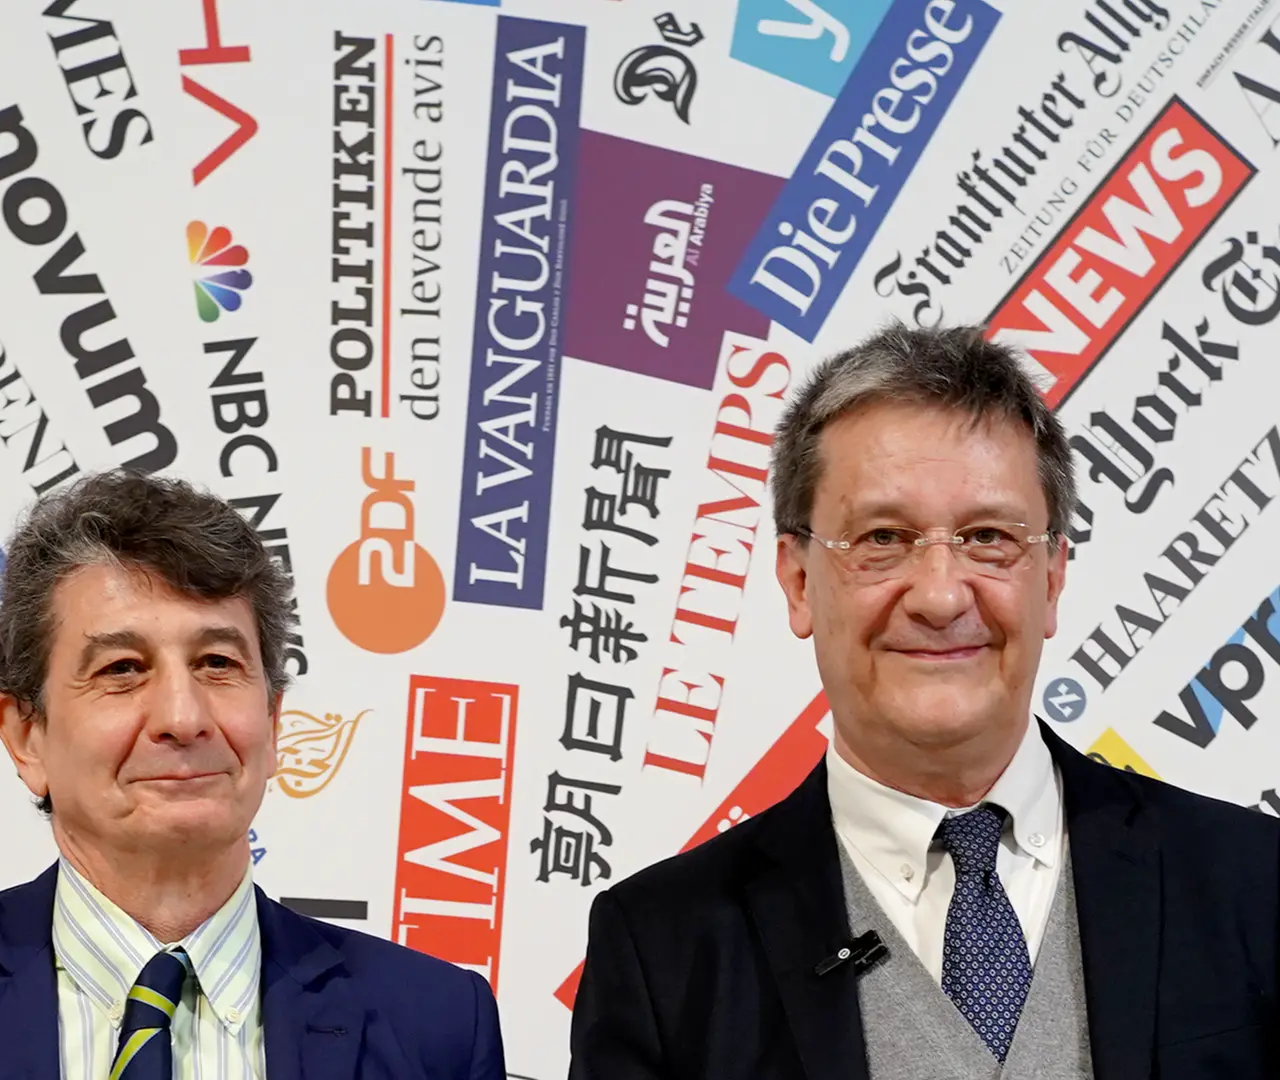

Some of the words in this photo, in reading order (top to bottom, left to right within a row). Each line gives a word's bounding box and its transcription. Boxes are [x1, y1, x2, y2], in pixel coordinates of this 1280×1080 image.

[411, 34, 444, 126] avis
[330, 31, 376, 417] POLITIKEN
[402, 138, 444, 320] levende
[688, 183, 715, 247] Arabiya
[749, 197, 858, 317] Die
[814, 0, 973, 208] Presse
[999, 177, 1079, 276] ZEITUNG
[1077, 127, 1118, 174] FÜR
[477, 36, 566, 511] VANGUARDIA
[986, 127, 1223, 396] NEWS
[202, 336, 279, 478] NBC
[401, 347, 440, 421] den
[357, 445, 416, 589] ZDF
[469, 498, 529, 590] LA
[670, 343, 792, 645] TEMPS
[528, 424, 674, 888] 朝日新聞
[642, 666, 725, 788] LE
